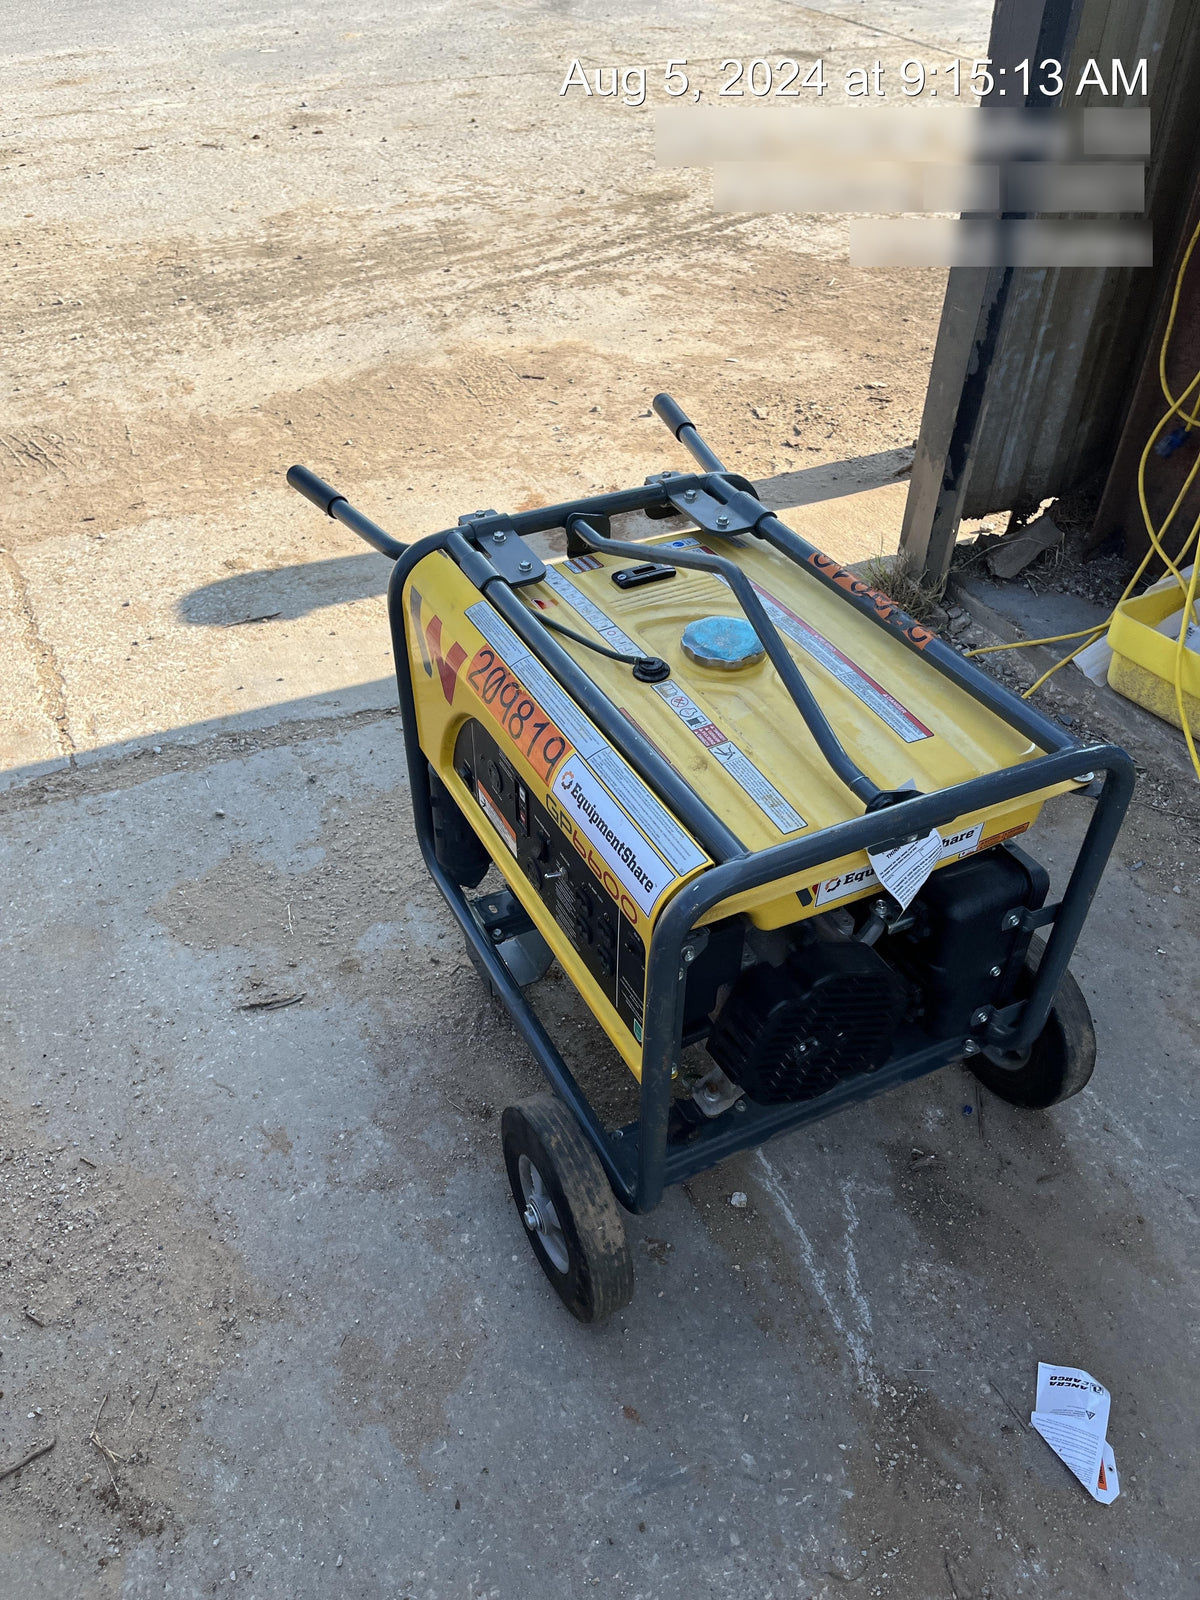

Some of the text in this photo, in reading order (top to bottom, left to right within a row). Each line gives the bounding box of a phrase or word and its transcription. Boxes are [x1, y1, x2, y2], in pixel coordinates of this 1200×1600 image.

[468, 650, 566, 782] 209819
[546, 793, 638, 925] GP6600
[571, 782, 656, 893] EquipmentShare
